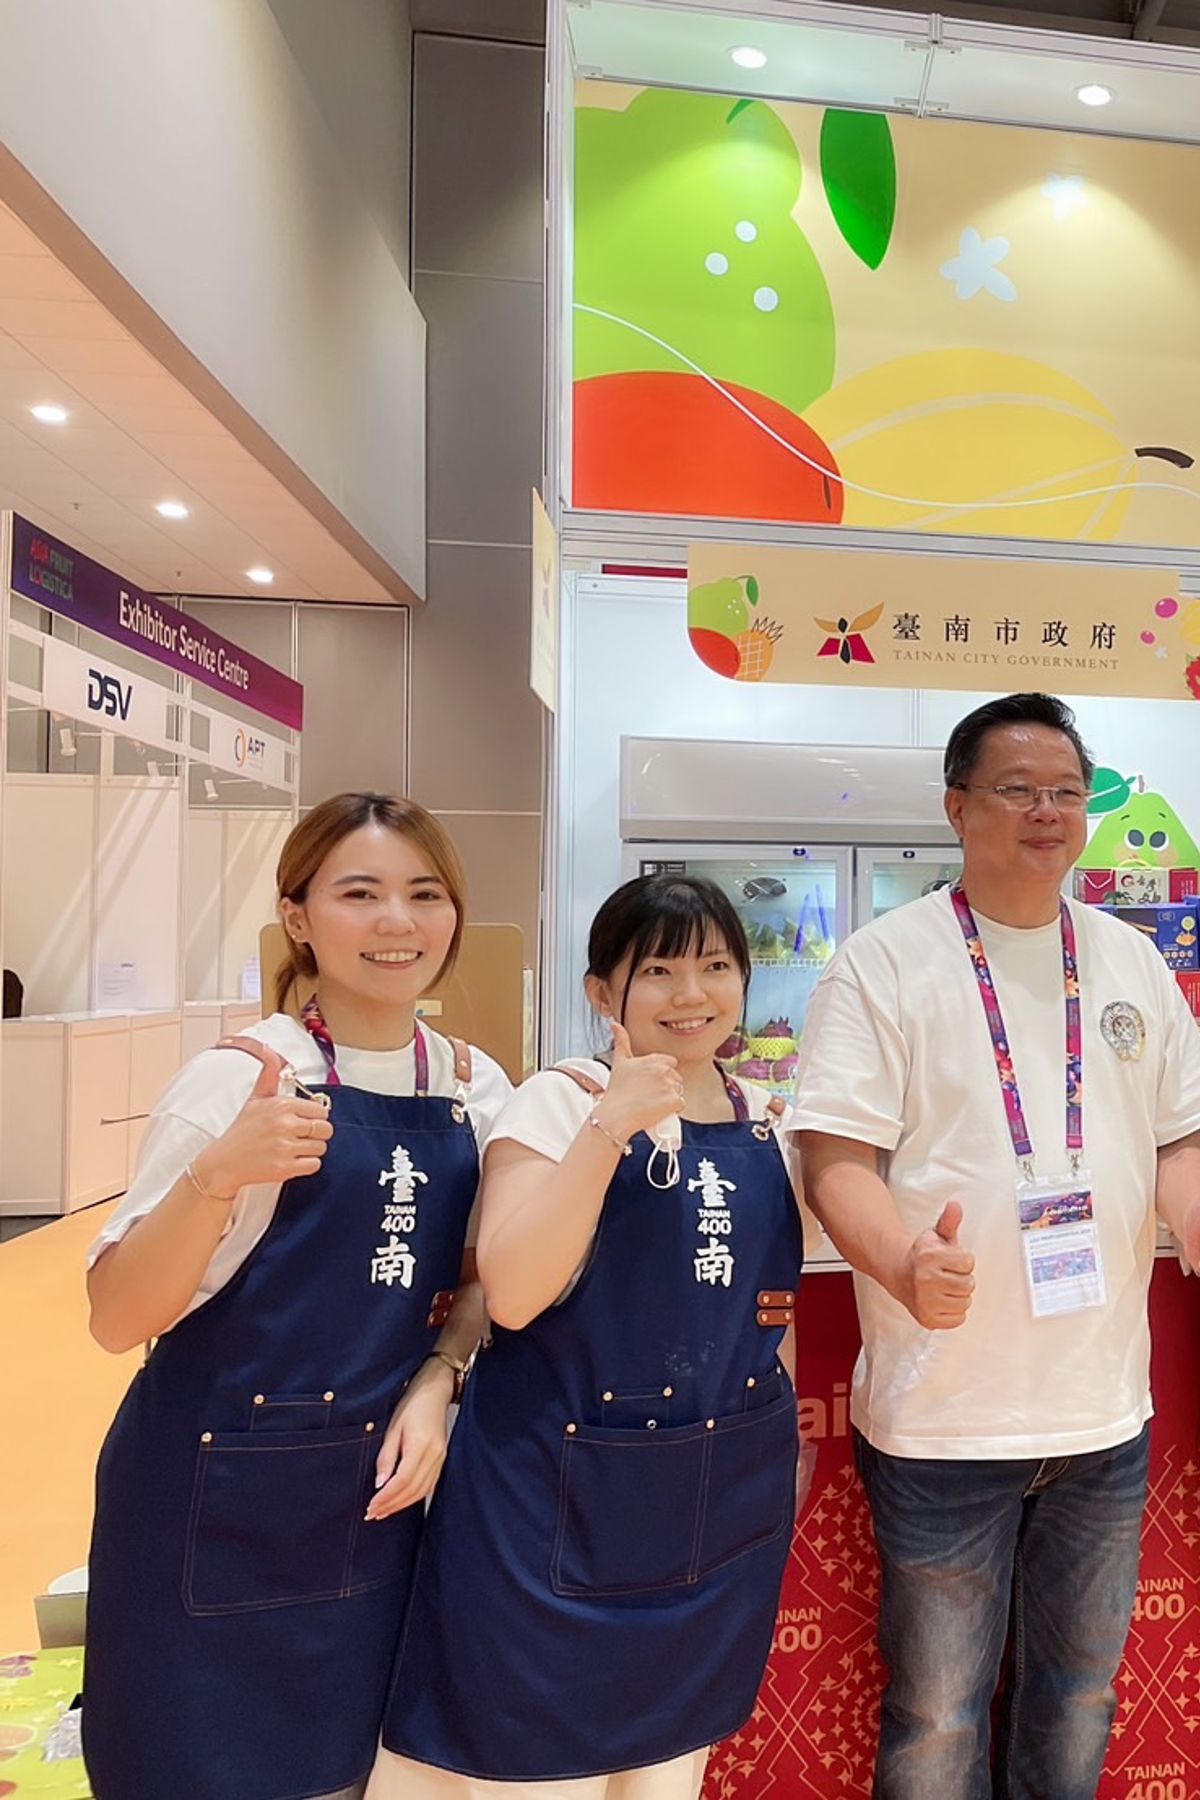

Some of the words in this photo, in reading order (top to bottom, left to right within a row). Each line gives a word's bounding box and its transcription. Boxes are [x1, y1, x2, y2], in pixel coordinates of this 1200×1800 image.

[119, 590, 178, 651] Exhibitor
[179, 625, 216, 672] Service
[217, 648, 249, 690] Centre
[892, 611, 1117, 650] 臺南市政府
[893, 649, 956, 662] TAINAN
[963, 652, 1000, 664] CITY
[1007, 654, 1120, 670] GOVERNMENT
[88, 668, 133, 721] DSV
[247, 737, 266, 758] APT
[378, 1144, 429, 1203] 臺
[687, 1157, 737, 1208] 臺
[381, 1215, 415, 1233] 400
[697, 1219, 732, 1235] 400
[371, 1235, 416, 1289] 南
[693, 1237, 735, 1288] 南
[798, 1383, 847, 1438] ai
[1136, 1577, 1184, 1593] AINAN
[778, 1606, 821, 1624] INAN
[1132, 1593, 1185, 1622] 400
[774, 1624, 822, 1653] 00
[1124, 1762, 1185, 1781] TAINAN
[1125, 1778, 1187, 1800] 400
